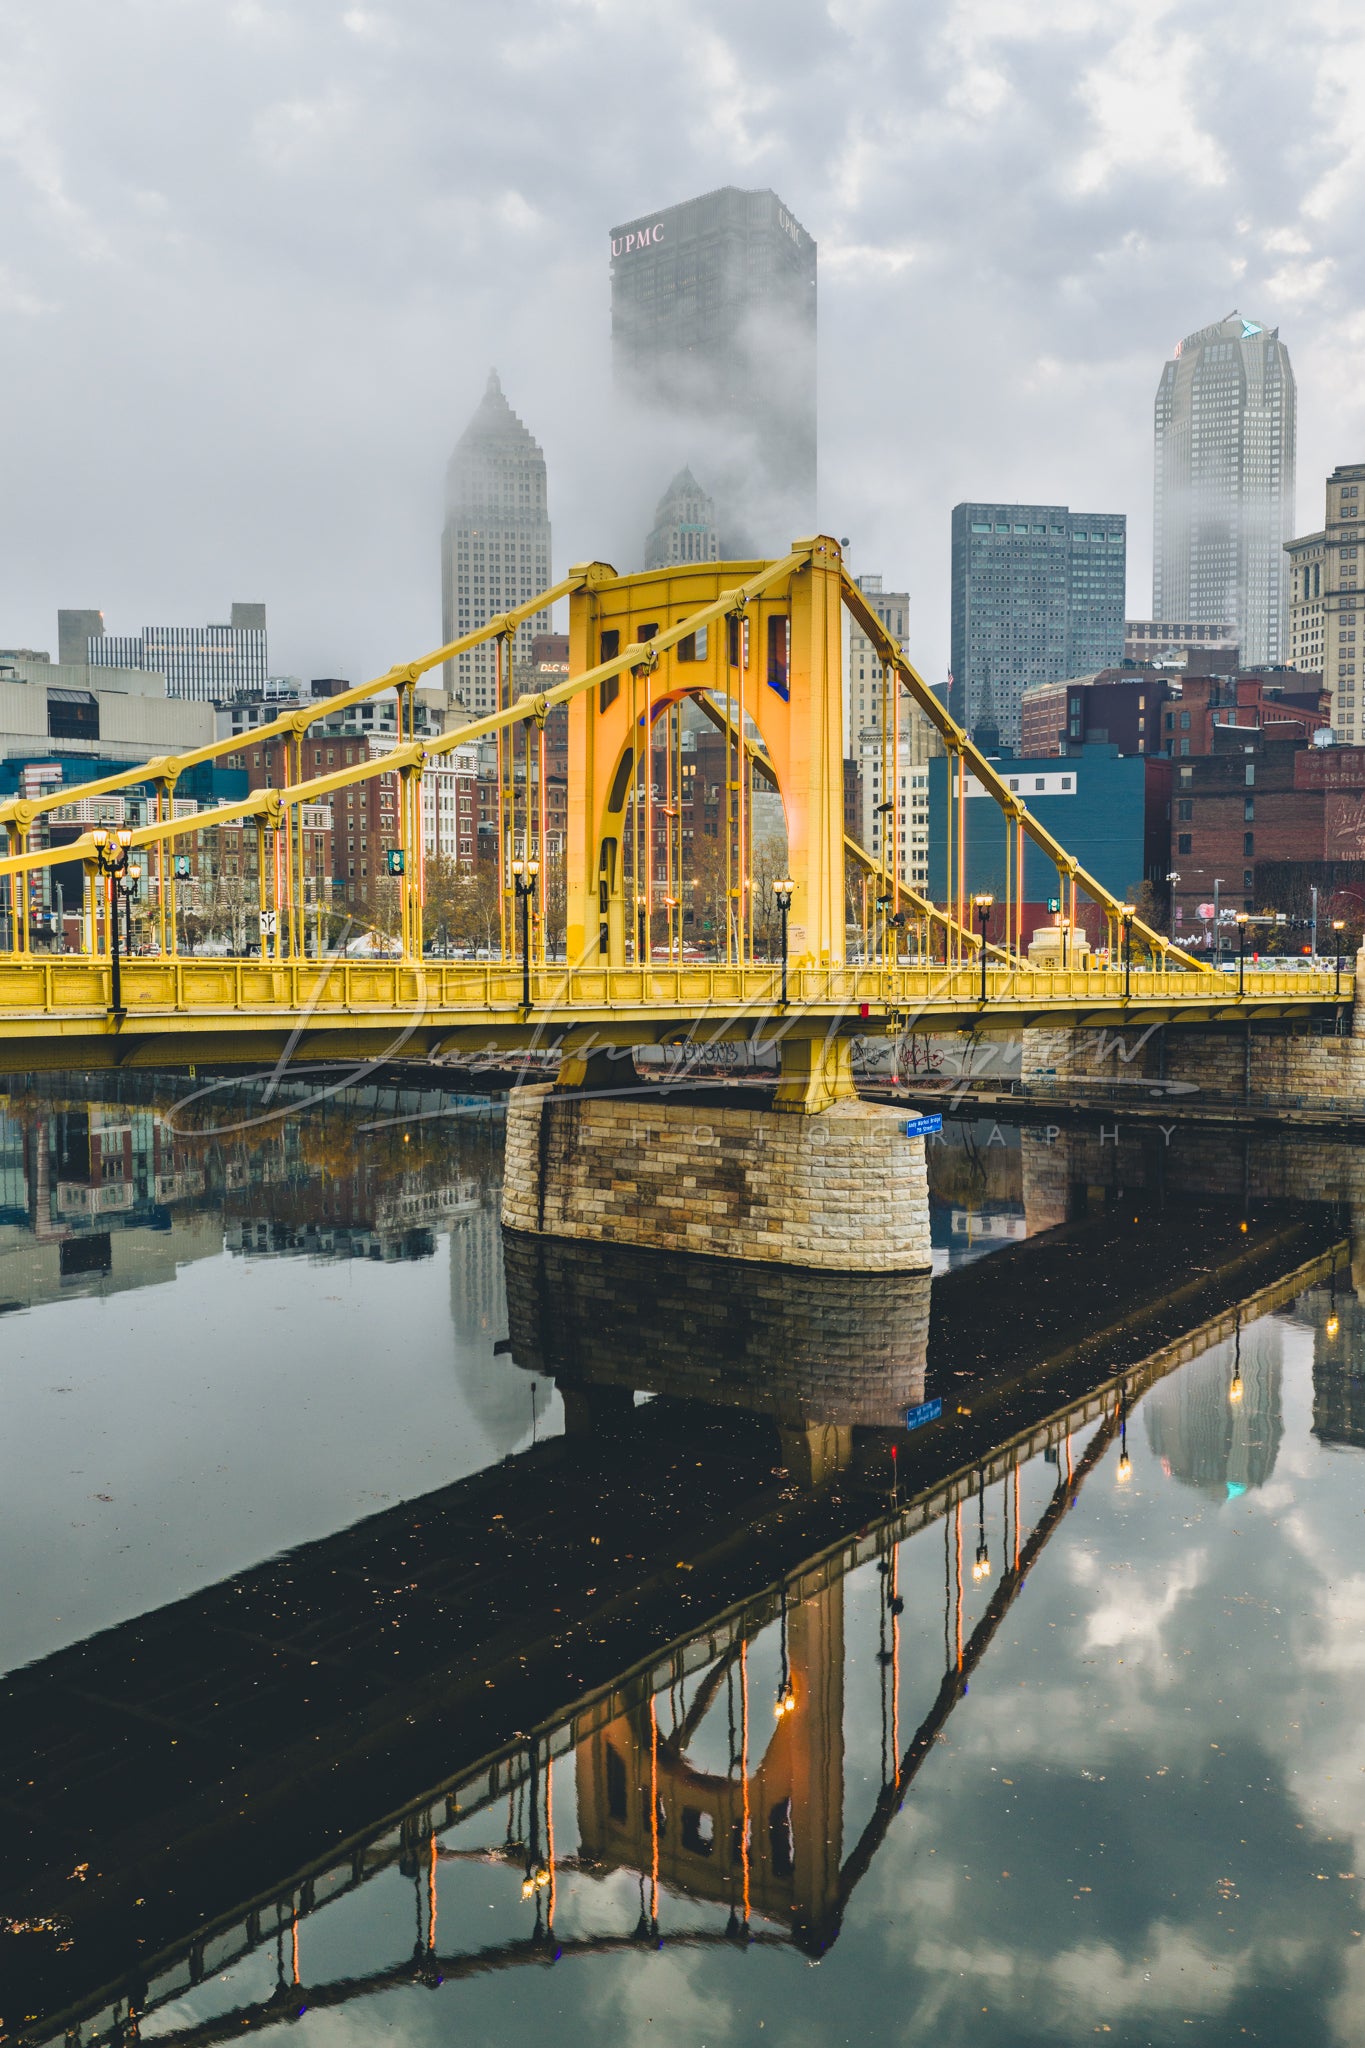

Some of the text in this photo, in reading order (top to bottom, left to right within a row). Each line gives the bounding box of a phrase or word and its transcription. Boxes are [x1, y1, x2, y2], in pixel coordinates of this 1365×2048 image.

[776, 207, 801, 248] UPMC
[611, 223, 664, 257] UPMC
[540, 663, 560, 672] DLC
[930, 1116, 941, 1124] Bridge
